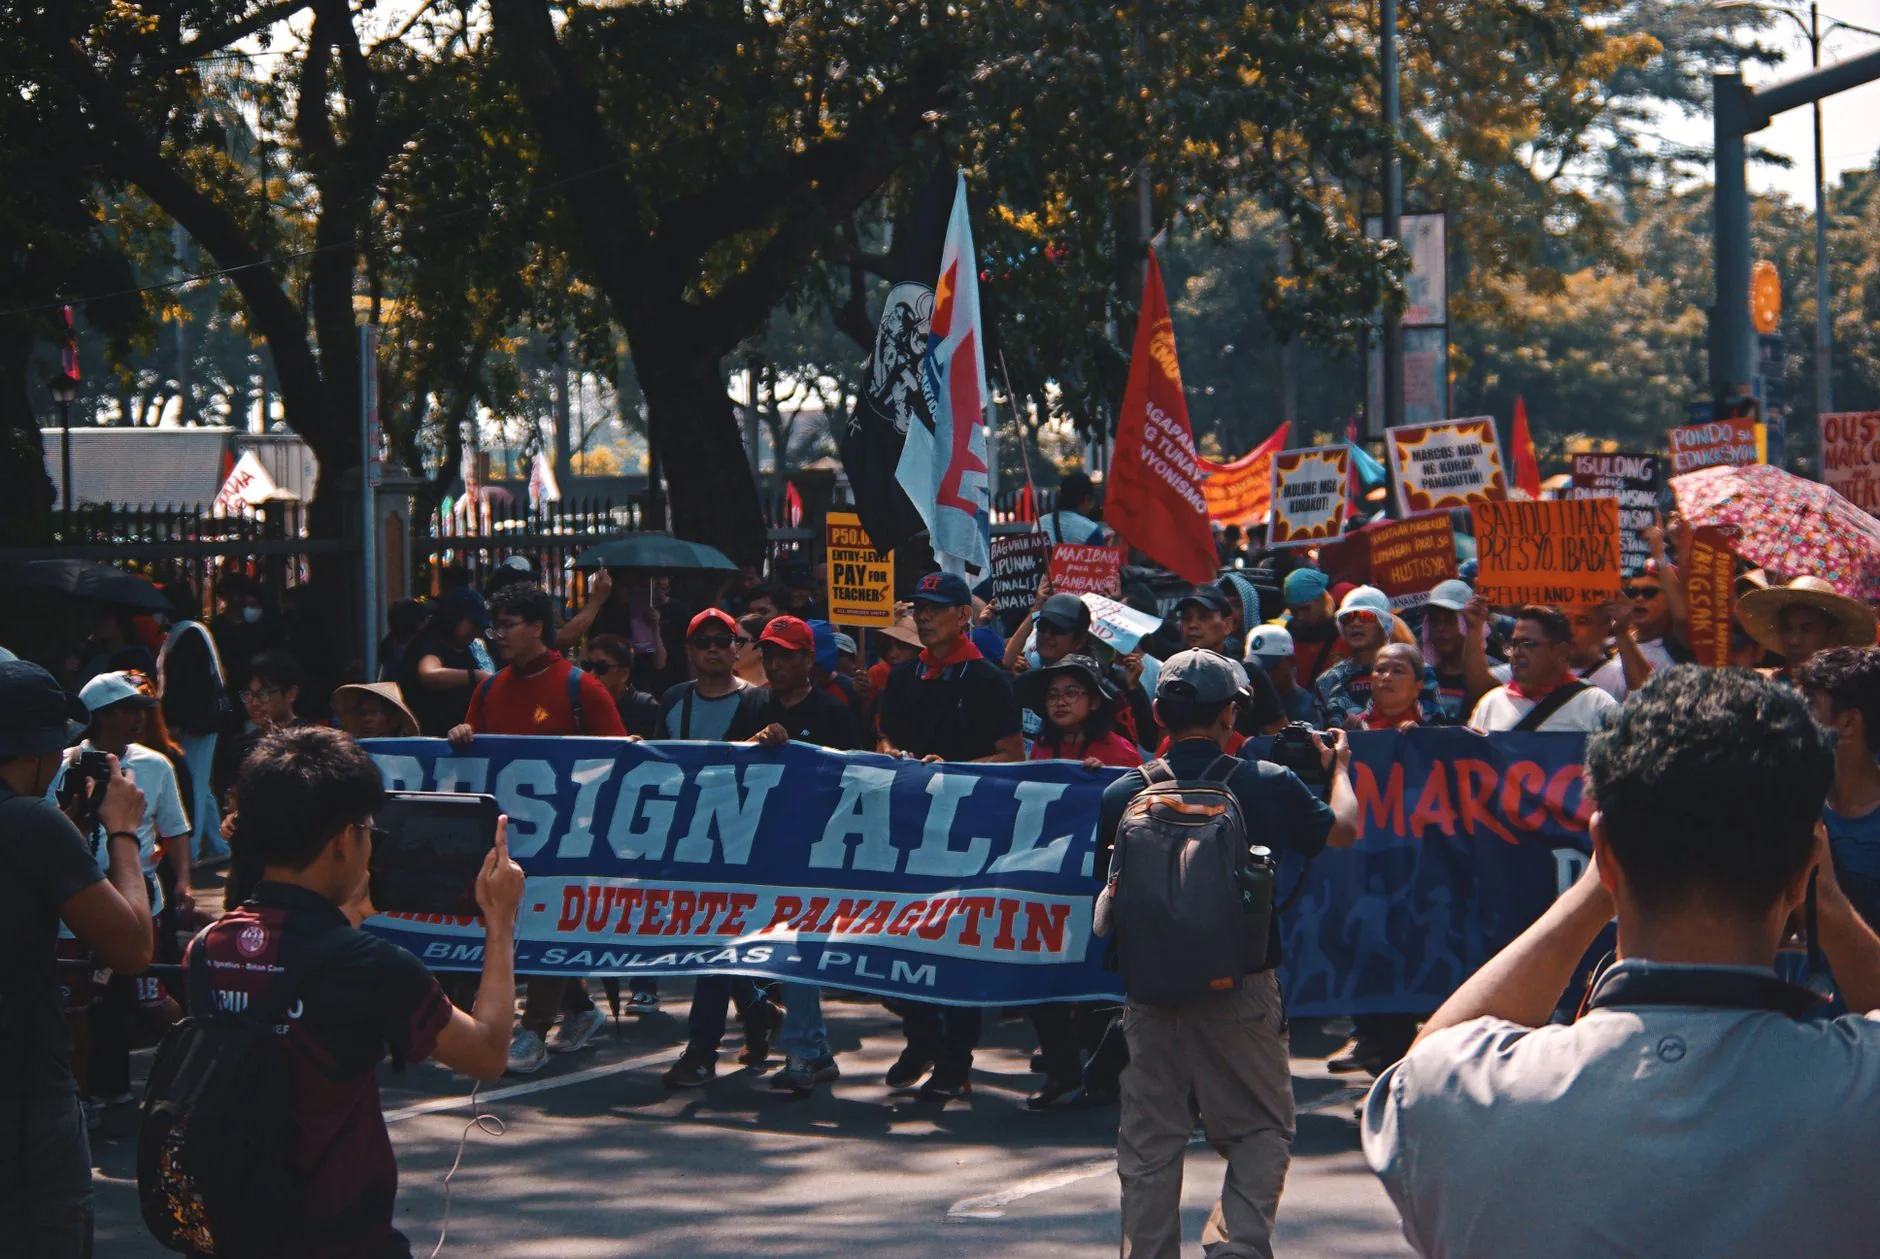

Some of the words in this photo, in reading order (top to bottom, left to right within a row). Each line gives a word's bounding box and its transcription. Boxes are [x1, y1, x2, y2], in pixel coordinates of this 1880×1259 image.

[1674, 423, 1732, 453] PONDO
[1412, 445, 1455, 462] MARCOS
[1457, 442, 1483, 459] HARI
[1423, 461, 1437, 476] NG
[1576, 455, 1653, 481] ISULONG
[1284, 481, 1317, 497] IKULONG
[1320, 479, 1337, 494] MGA
[1422, 472, 1484, 489] PANAGUTIN!
[1561, 535, 1618, 573] IBABA
[833, 563, 866, 586] PAY
[868, 571, 887, 582] FOR
[832, 585, 890, 602] TEACHERS
[1355, 758, 1595, 844] MARCO
[557, 885, 757, 936] DUTERTE
[759, 894, 1071, 954] PANAGUTIN
[423, 942, 486, 961] BM
[540, 945, 773, 967] SANLAKAS
[817, 950, 937, 987] PLM
